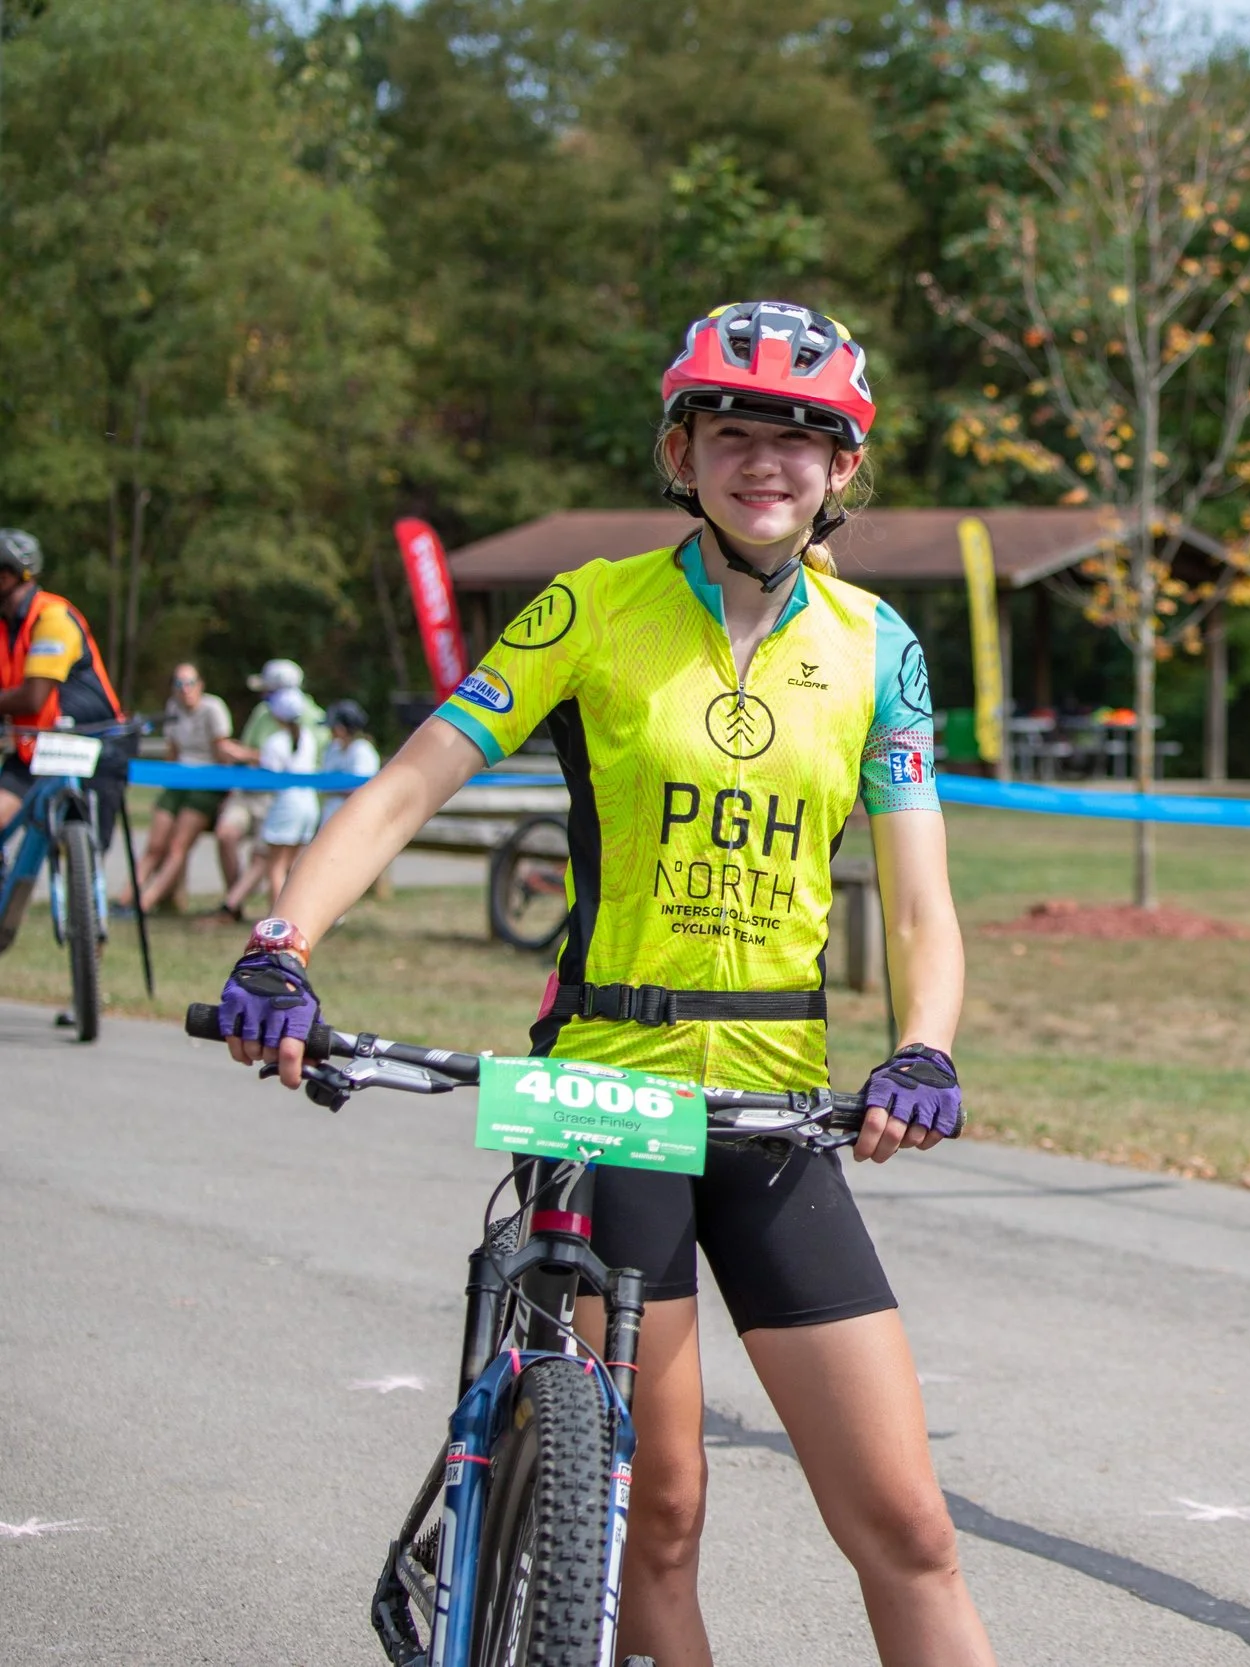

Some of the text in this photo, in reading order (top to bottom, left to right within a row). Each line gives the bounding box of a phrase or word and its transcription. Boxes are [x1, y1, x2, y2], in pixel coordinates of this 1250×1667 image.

[788, 678, 829, 691] CUORE
[892, 755, 904, 781] NICA
[660, 782, 806, 861] PGH
[671, 923, 766, 946] CYCLING TEAM
[515, 1070, 674, 1118] 4006
[553, 1111, 641, 1131] Grace Finley
[561, 1130, 624, 1146] TREK
